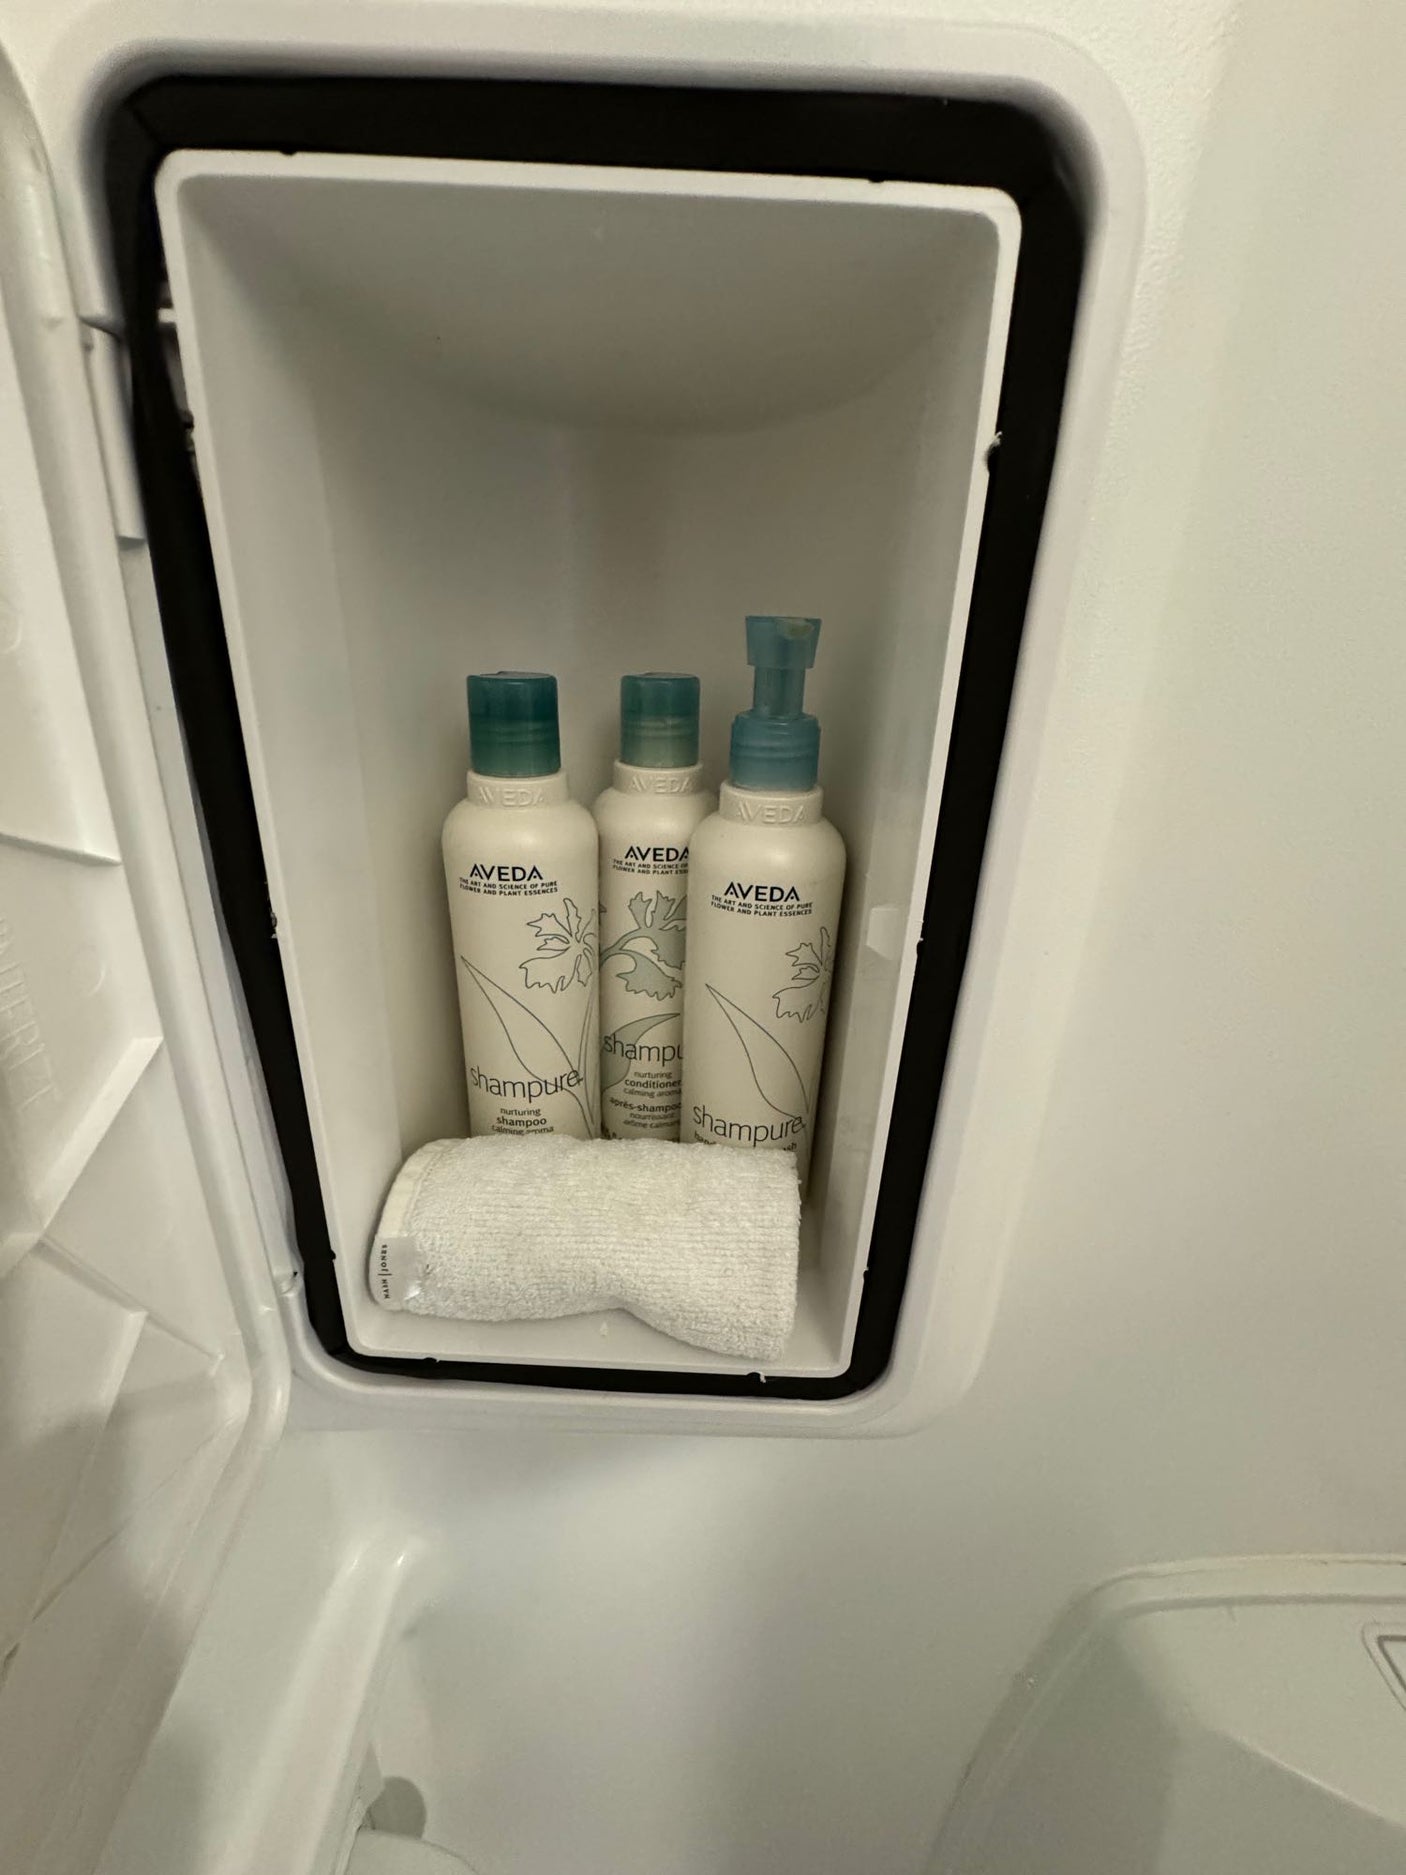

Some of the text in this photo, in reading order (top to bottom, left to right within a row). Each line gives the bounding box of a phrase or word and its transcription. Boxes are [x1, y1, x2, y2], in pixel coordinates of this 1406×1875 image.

[624, 845, 690, 863] AVEDA
[469, 862, 544, 883] AVEDA
[459, 877, 470, 886] THE
[470, 880, 482, 888] ART
[540, 880, 558, 888] PURE
[459, 884, 482, 893] FLOWER
[524, 887, 559, 897] ESSENCES
[723, 881, 801, 903] AVEDA
[711, 894, 722, 904] THE
[723, 899, 737, 907] ART
[754, 903, 784, 911] SCIENCE
[796, 902, 814, 910] PURE
[711, 901, 735, 912] FLOWER
[779, 909, 812, 917] ESSENCES
[602, 1032, 684, 1067] shampu
[469, 1063, 581, 1103] shampure
[633, 1071, 673, 1081] nurturing
[499, 1107, 543, 1117] nurturing
[496, 1115, 548, 1129] shampoo
[692, 1104, 804, 1148] shampure
